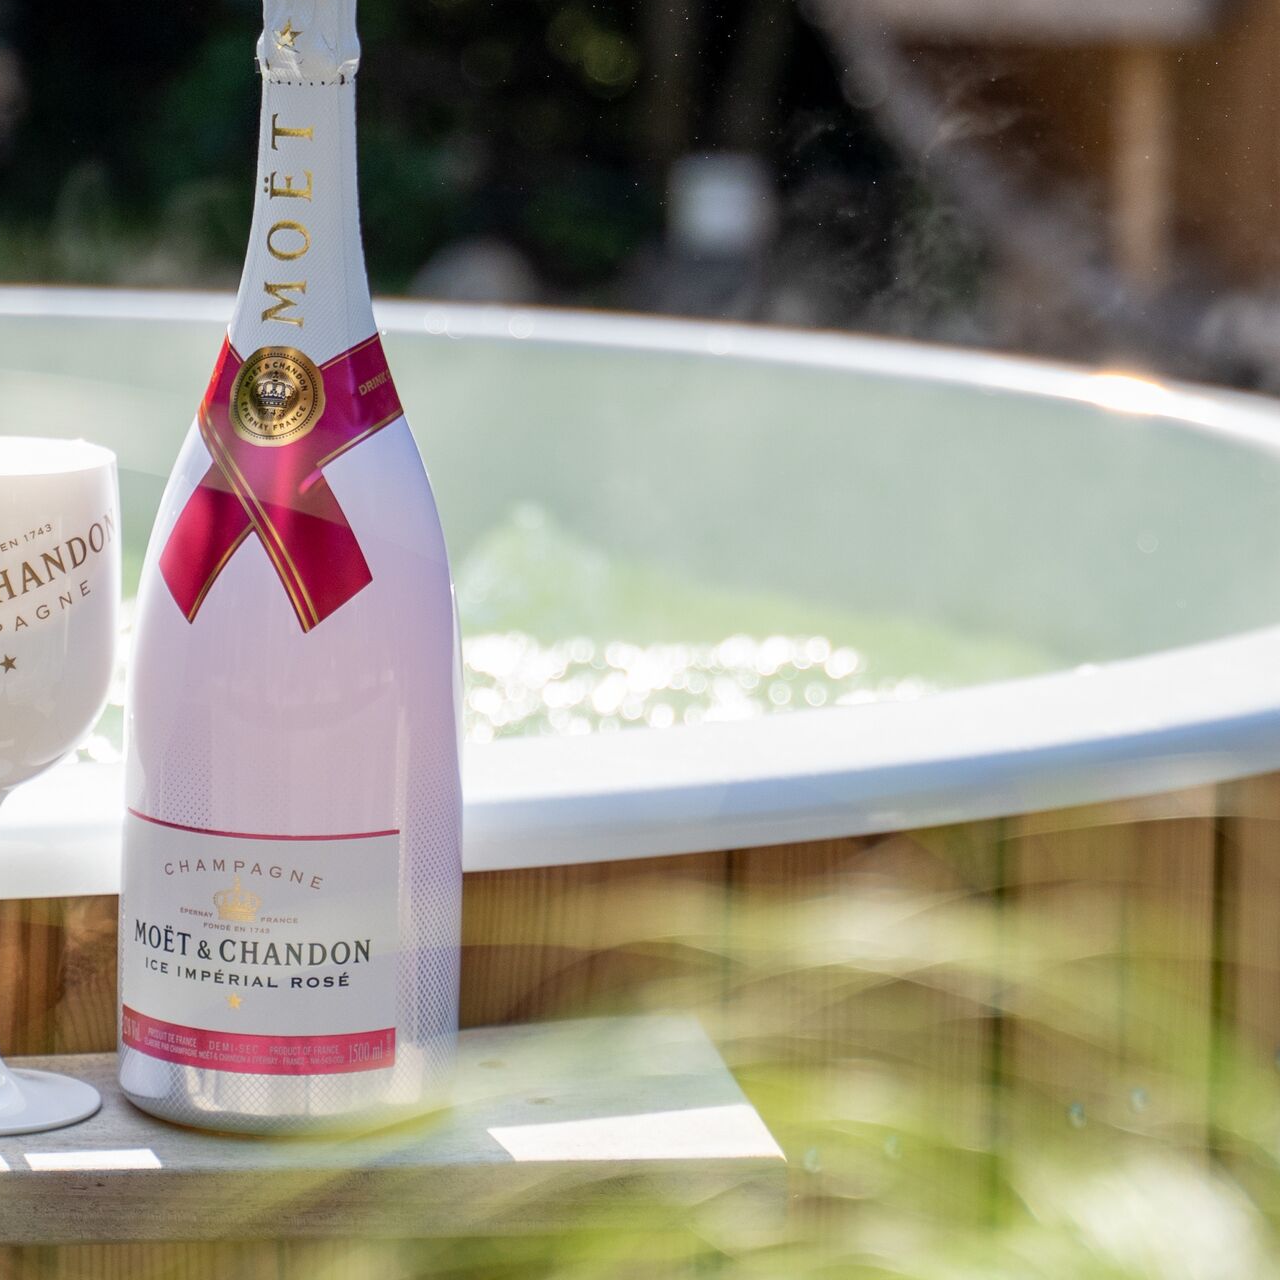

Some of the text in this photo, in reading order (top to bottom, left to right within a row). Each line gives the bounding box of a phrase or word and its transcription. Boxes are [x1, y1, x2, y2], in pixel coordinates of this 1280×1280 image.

[261, 113, 315, 328] MOËT
[273, 361, 309, 392] CHANDON
[358, 371, 387, 396] DRINK
[273, 405, 307, 431] FRANCE
[0, 540, 18, 552] EN
[24, 523, 52, 543] 1743
[164, 859, 323, 890] CHAMPAGNE
[260, 916, 299, 924] FRANCE
[134, 919, 372, 967] MOËT & CHANDON
[145, 956, 350, 989] ICE IMPÉRIAL ROSÉ
[168, 1033, 175, 1044] DE
[176, 1035, 197, 1048] FRANCE
[208, 1040, 259, 1054] DEMI-SEC
[269, 1045, 339, 1056] PRODUCT OF FRANCE
[349, 1042, 370, 1064] 1500
[372, 1039, 383, 1060] ml
